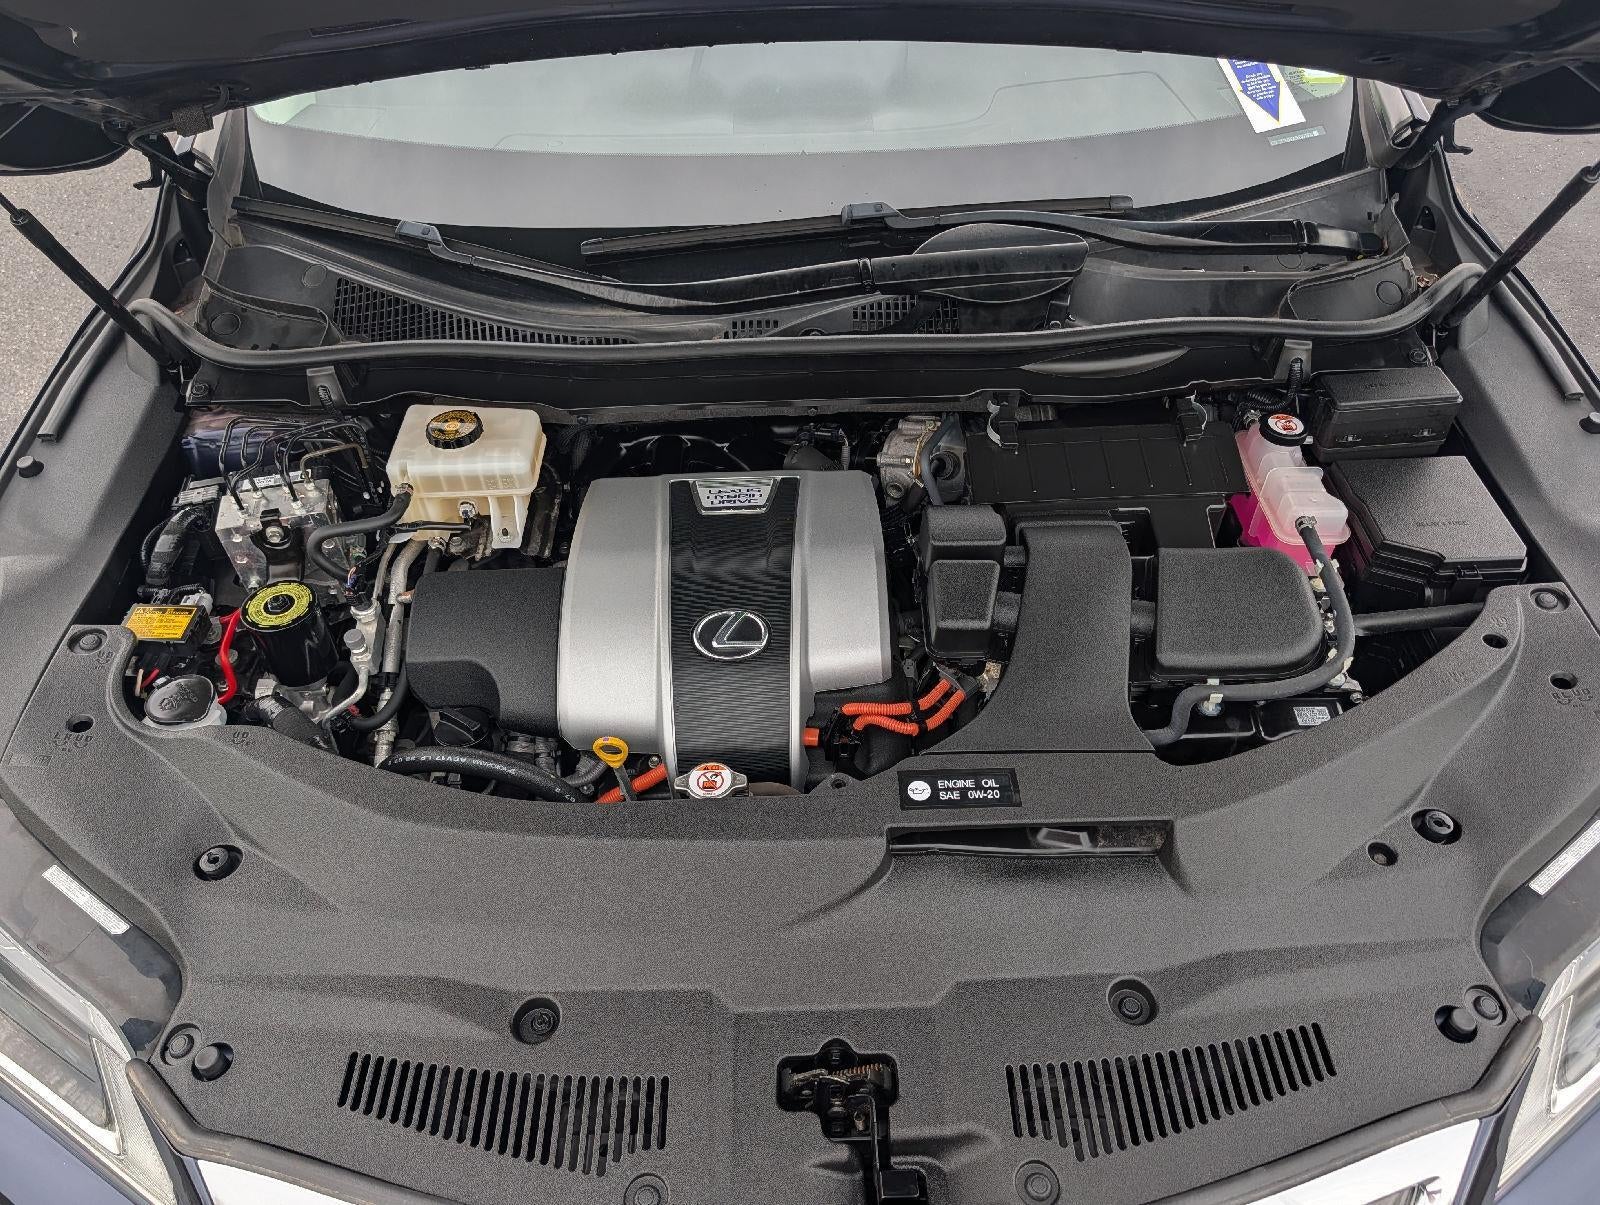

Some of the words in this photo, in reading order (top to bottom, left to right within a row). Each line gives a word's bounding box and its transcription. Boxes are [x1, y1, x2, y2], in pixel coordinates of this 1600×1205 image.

[938, 779, 976, 789] ENGINE
[982, 779, 1000, 788] OIL
[939, 790, 961, 800] SAE
[968, 789, 1000, 799] 0W-20
